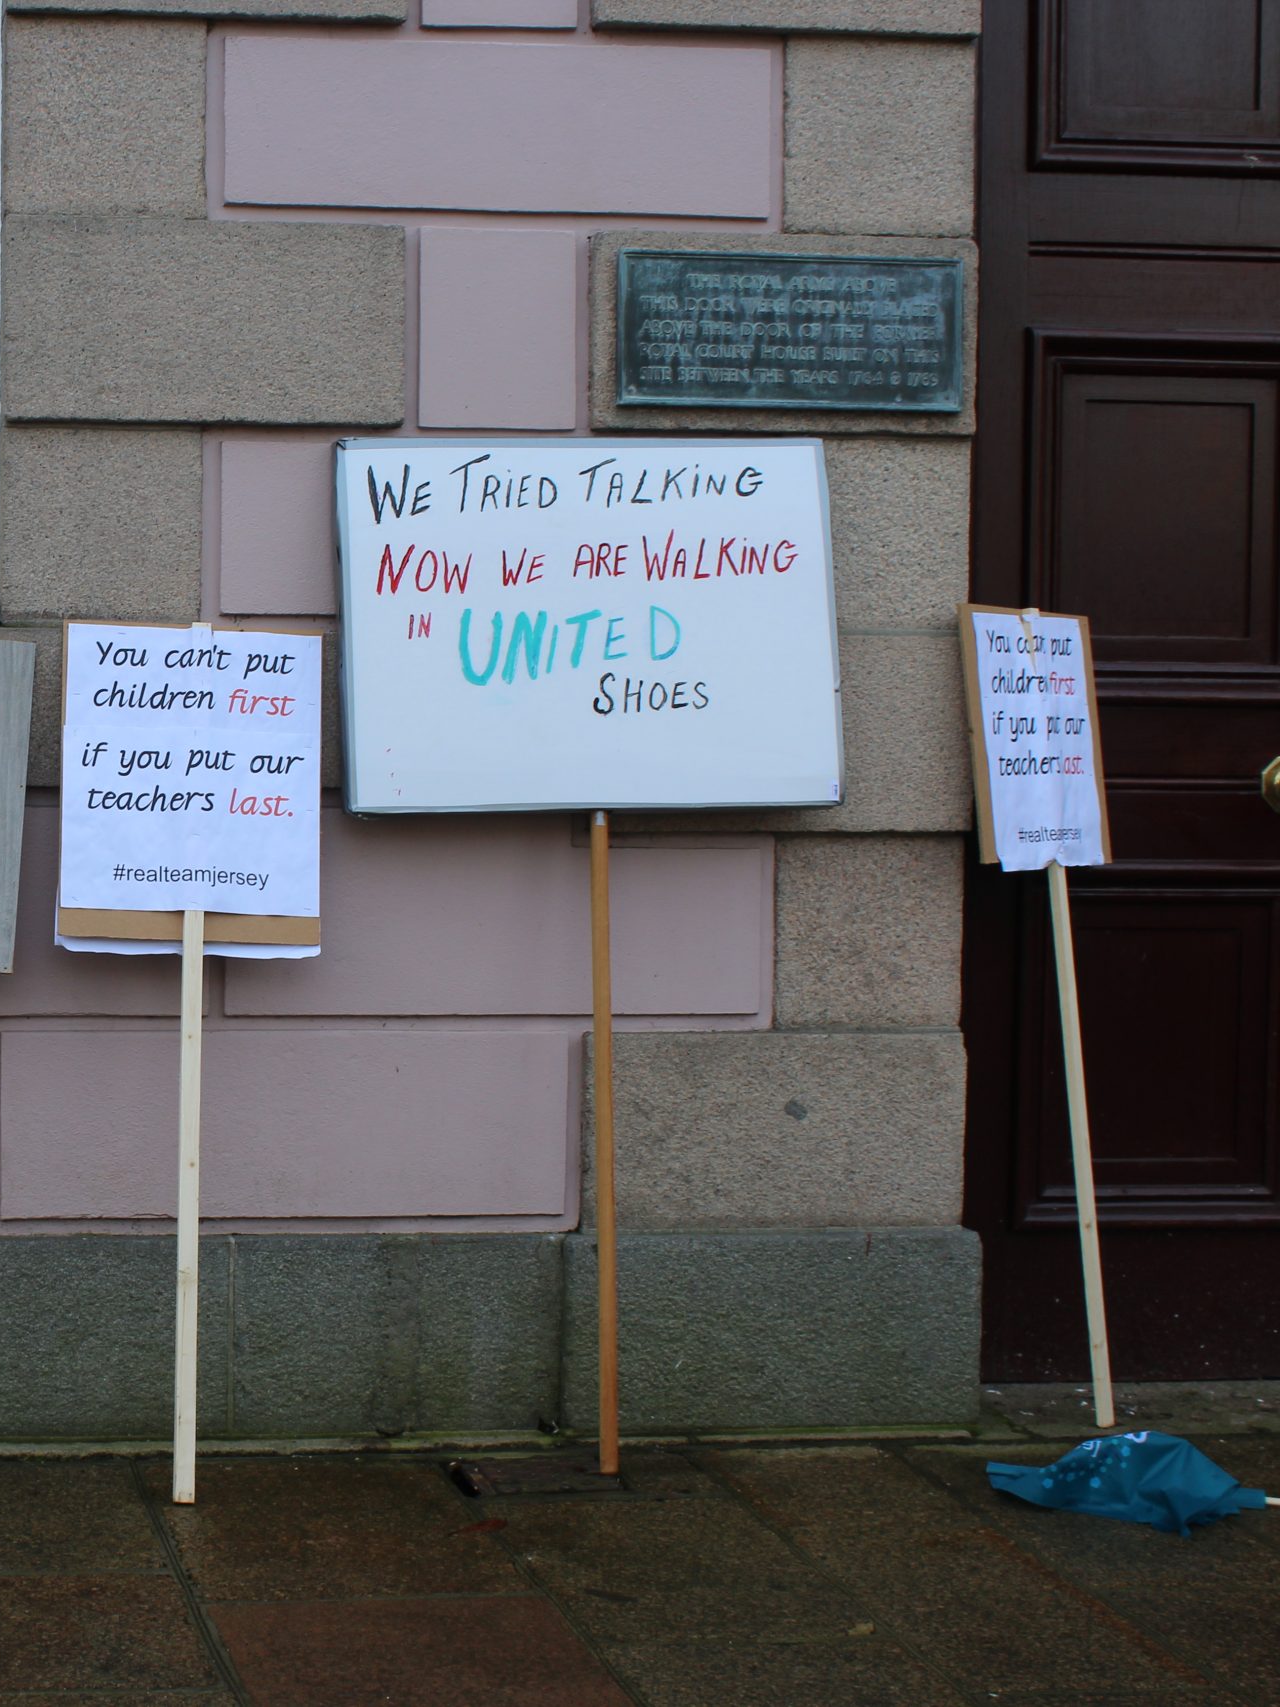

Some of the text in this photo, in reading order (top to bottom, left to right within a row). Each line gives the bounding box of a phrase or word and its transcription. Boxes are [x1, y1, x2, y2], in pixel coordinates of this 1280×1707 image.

[686, 273, 721, 289] THE
[842, 277, 897, 294] ABOVE
[639, 295, 678, 312] THIS
[685, 297, 735, 312] DOOR
[639, 319, 695, 338] ABOVE
[699, 320, 734, 336] THE
[741, 322, 791, 338] DOOR
[798, 322, 821, 338] OF
[830, 324, 865, 339] THE
[639, 342, 692, 359] ROYAL
[695, 343, 755, 359] COURT
[760, 345, 816, 360] HOUSE
[872, 348, 898, 364] ON
[904, 348, 940, 364] THIS
[639, 366, 672, 381] SITE
[677, 367, 751, 384] BETWEEN
[752, 368, 785, 384] THE
[789, 369, 839, 384] YEARS
[367, 463, 432, 525] WE
[376, 543, 473, 595] NOW
[501, 548, 544, 587] WE
[572, 542, 629, 581] ARE
[95, 641, 296, 680] You can't put
[408, 605, 682, 686] IN UNITED
[986, 629, 1011, 653] You
[1050, 637, 1072, 662] put
[93, 681, 296, 717] children first
[593, 672, 710, 717] SHOES
[1049, 671, 1075, 695] first
[992, 710, 1004, 735] if
[1009, 717, 1036, 742] you
[1065, 717, 1085, 735] our
[81, 742, 305, 776] if you put our
[87, 785, 294, 818] teachers last.
[113, 863, 269, 891] #realteamjersey
